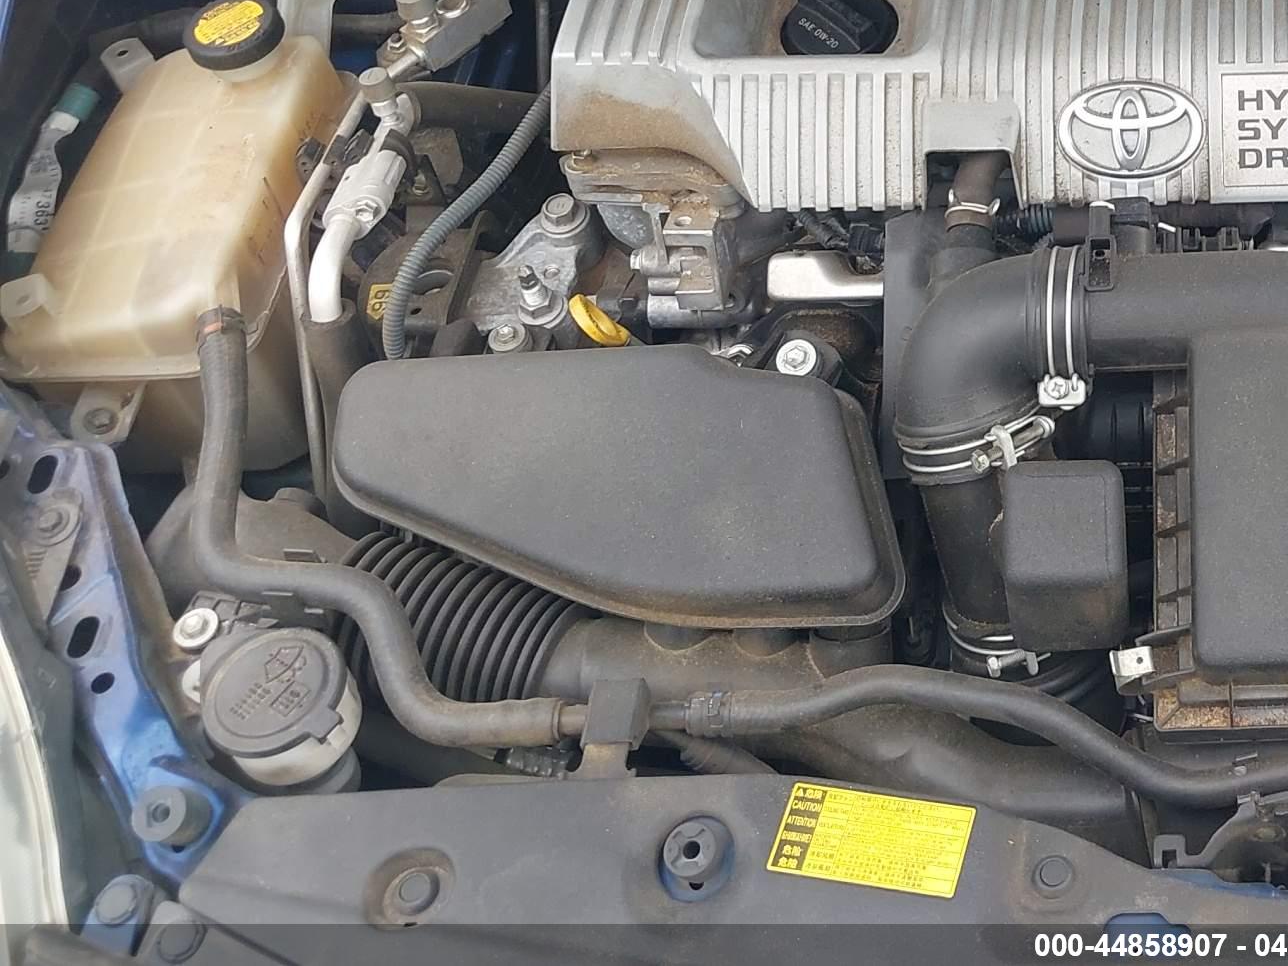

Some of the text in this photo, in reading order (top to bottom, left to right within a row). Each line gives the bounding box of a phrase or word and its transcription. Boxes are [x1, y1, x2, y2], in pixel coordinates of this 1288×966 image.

[798, 17, 816, 32] SAE
[791, 799, 823, 813] CAUTION
[786, 815, 818, 828] ATTENTION
